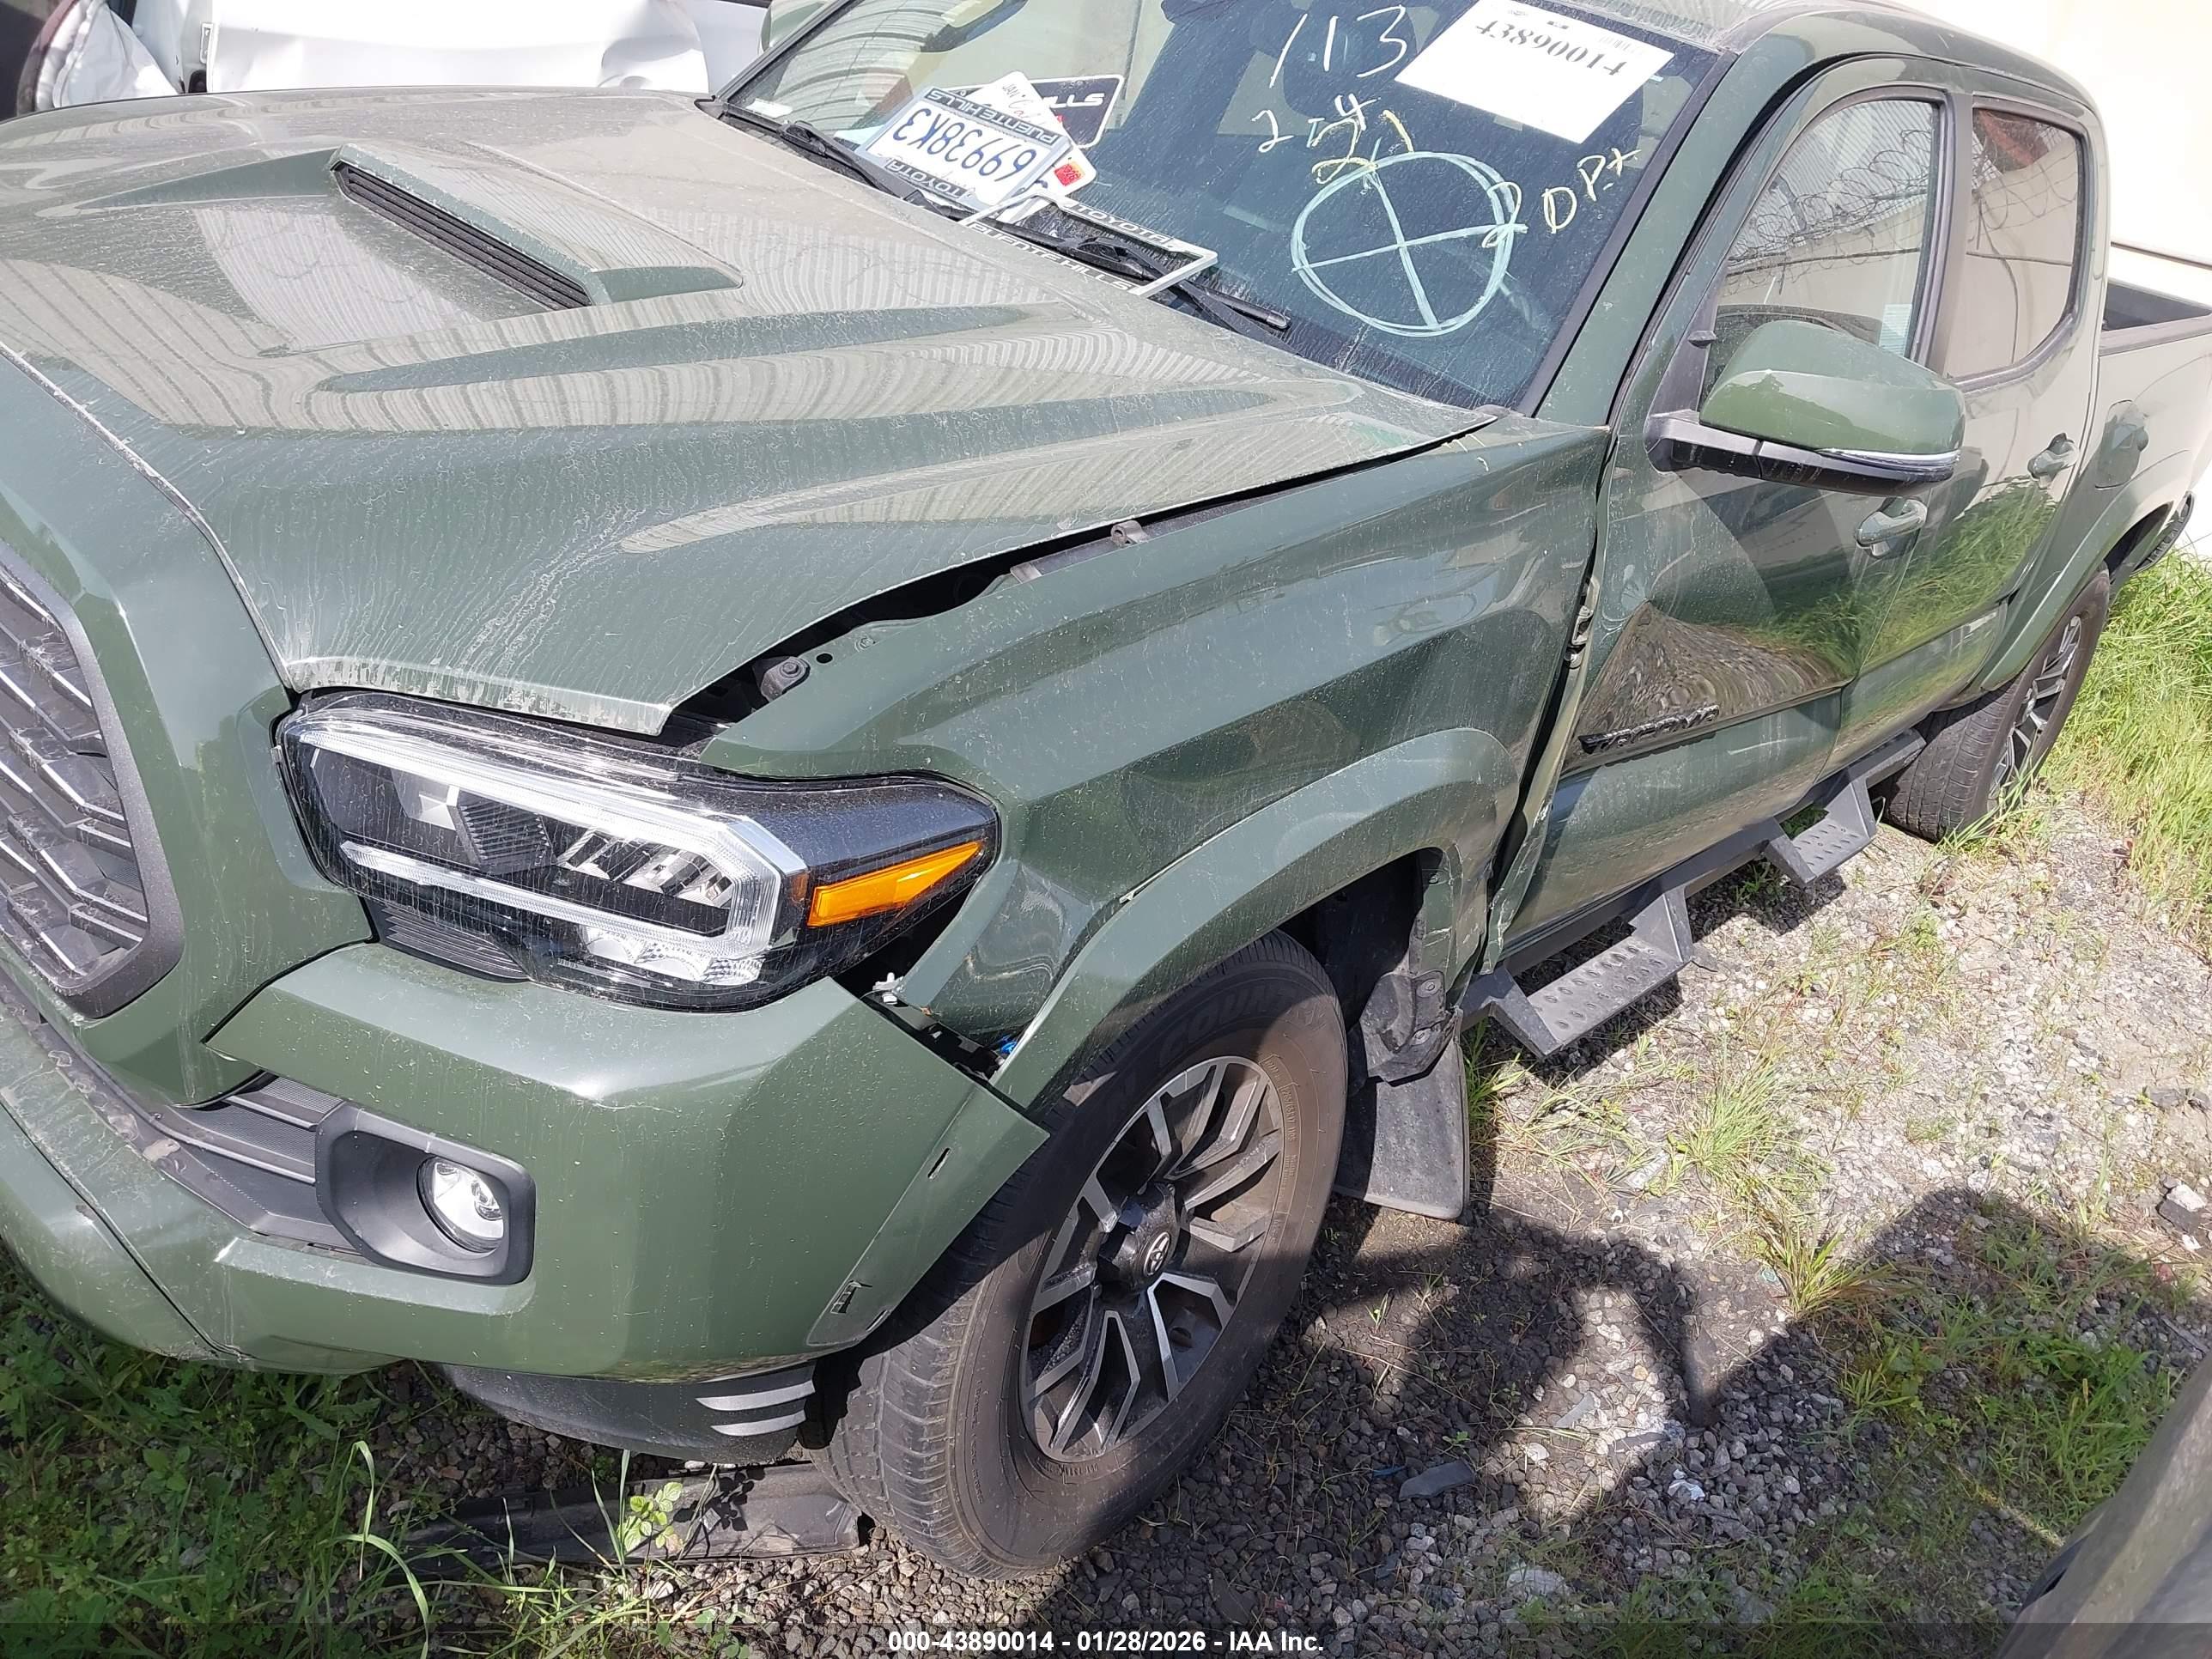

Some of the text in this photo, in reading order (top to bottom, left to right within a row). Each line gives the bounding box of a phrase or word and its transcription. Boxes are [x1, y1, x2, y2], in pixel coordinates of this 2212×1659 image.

[1474, 19, 1628, 76] 43890014
[927, 88, 981, 116] HILLS
[981, 106, 1059, 144] PUENTE
[892, 107, 1037, 183] 69938K3
[890, 162, 961, 198] TOYOTA
[1077, 204, 1170, 245] TOYOTA
